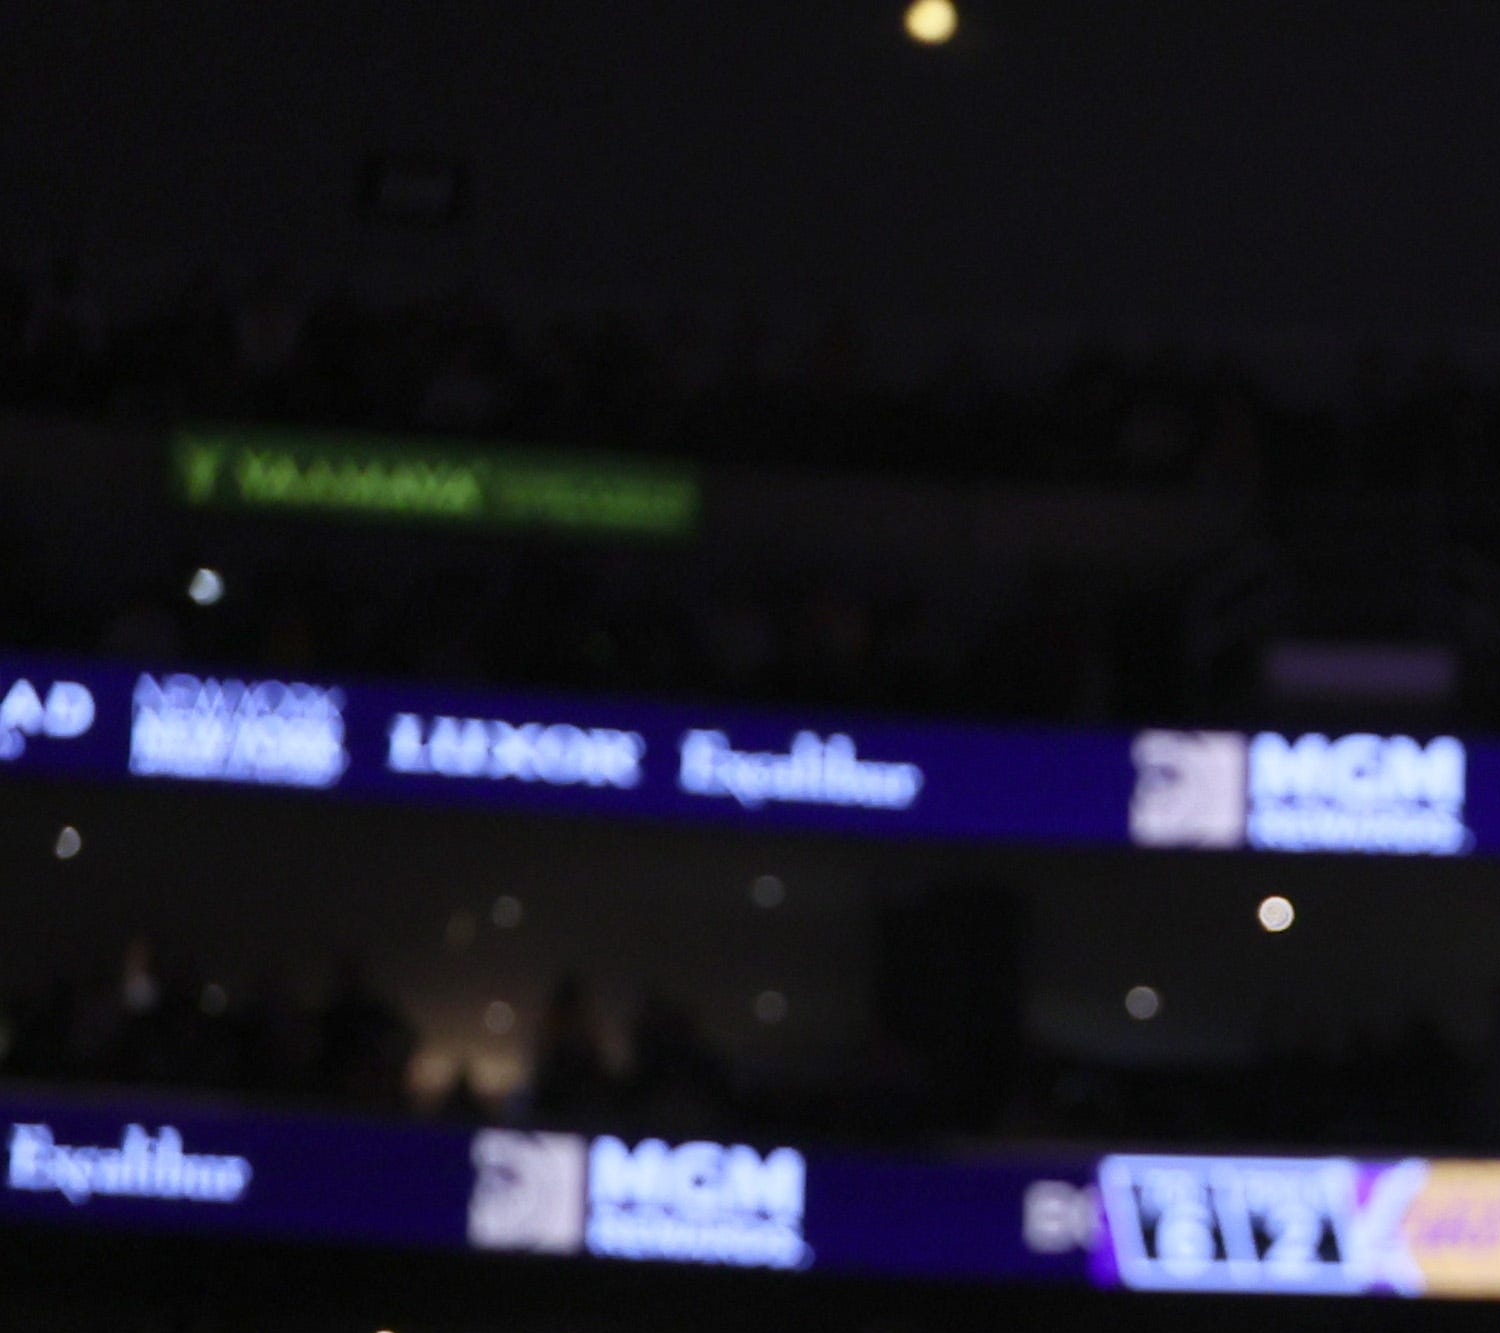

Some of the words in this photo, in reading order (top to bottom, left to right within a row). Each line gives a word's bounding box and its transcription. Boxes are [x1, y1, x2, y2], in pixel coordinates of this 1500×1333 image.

[390, 712, 646, 789] LUXOR
[1247, 731, 1467, 799] MGM
[588, 1134, 804, 1207] MGM
